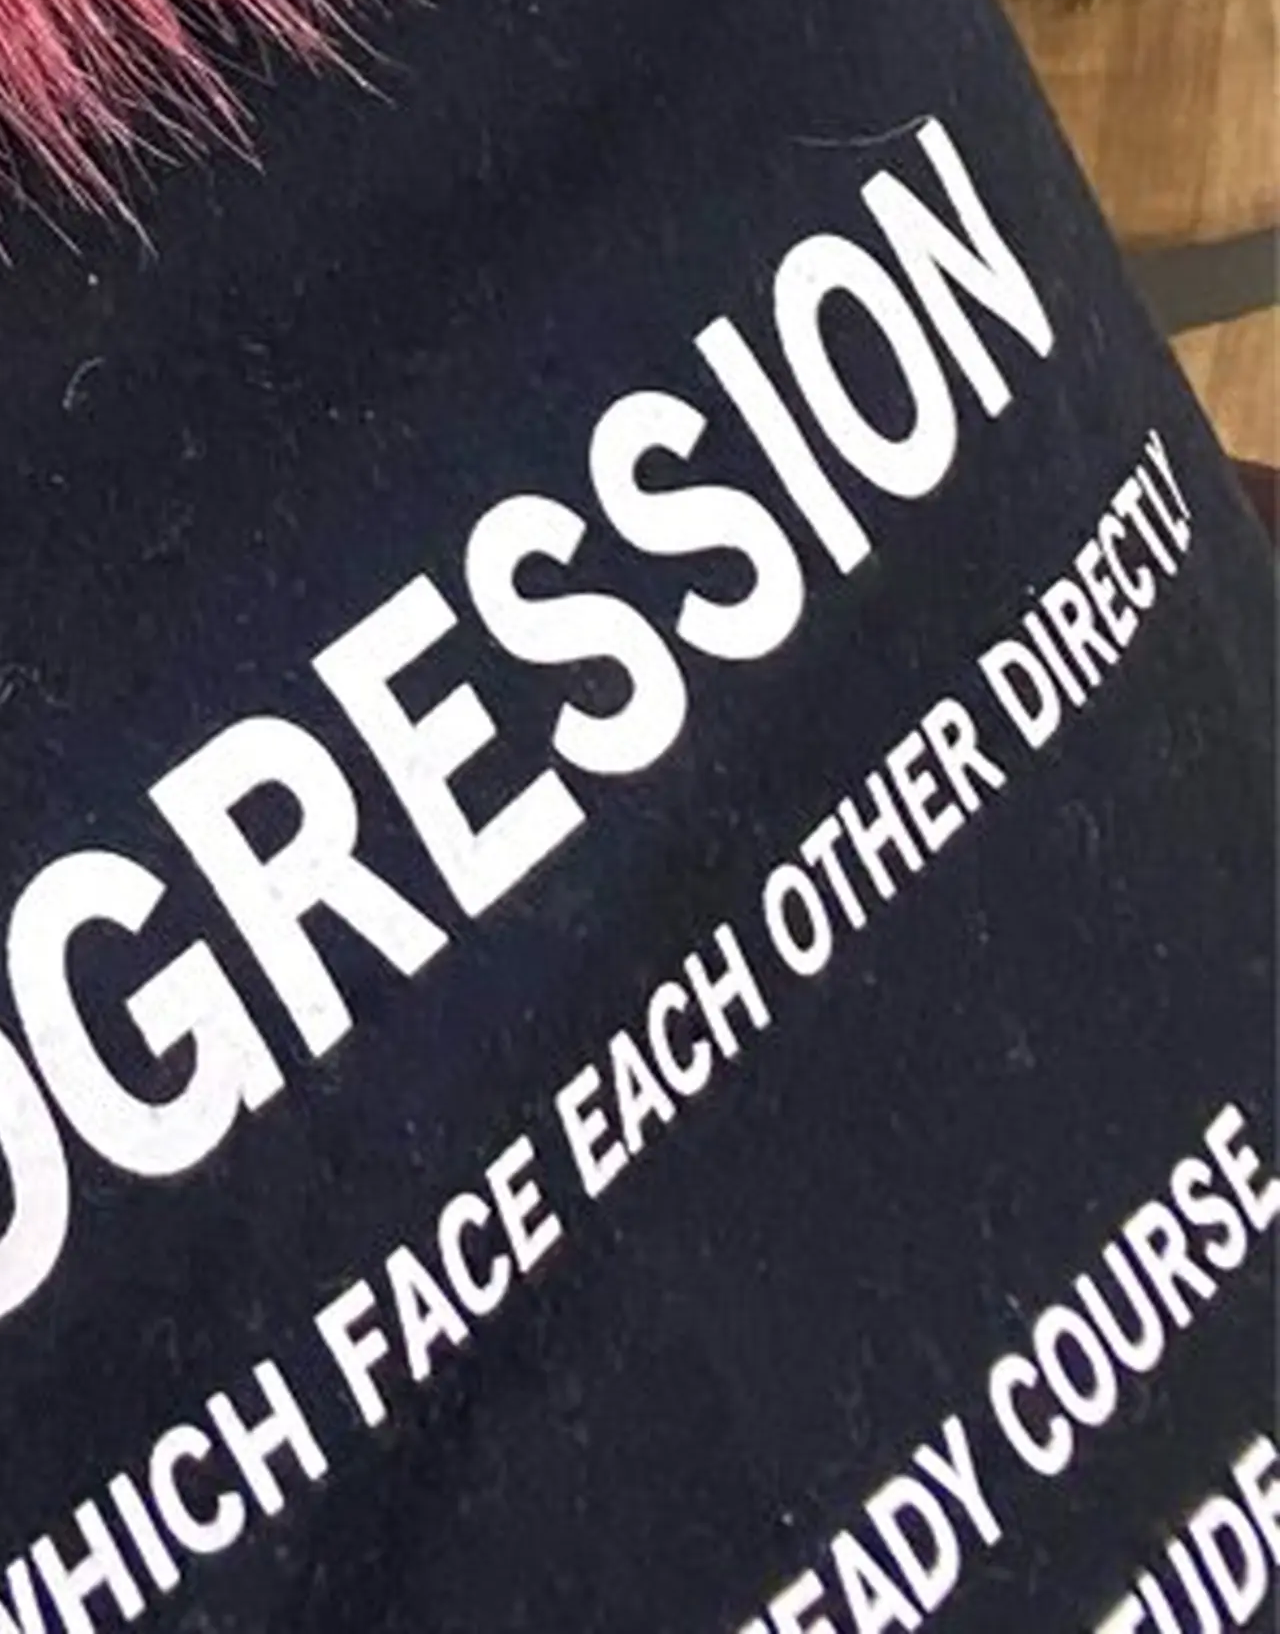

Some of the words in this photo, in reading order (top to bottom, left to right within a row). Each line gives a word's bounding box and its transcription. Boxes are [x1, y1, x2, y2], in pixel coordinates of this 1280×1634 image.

[314, 1135, 562, 1427] FACE
[555, 923, 771, 1198] EACH
[762, 697, 1006, 976] OTHER
[977, 429, 1192, 749] DIRECTLY
[738, 1415, 1002, 1634] ADY
[989, 1102, 1280, 1476] COURSE
